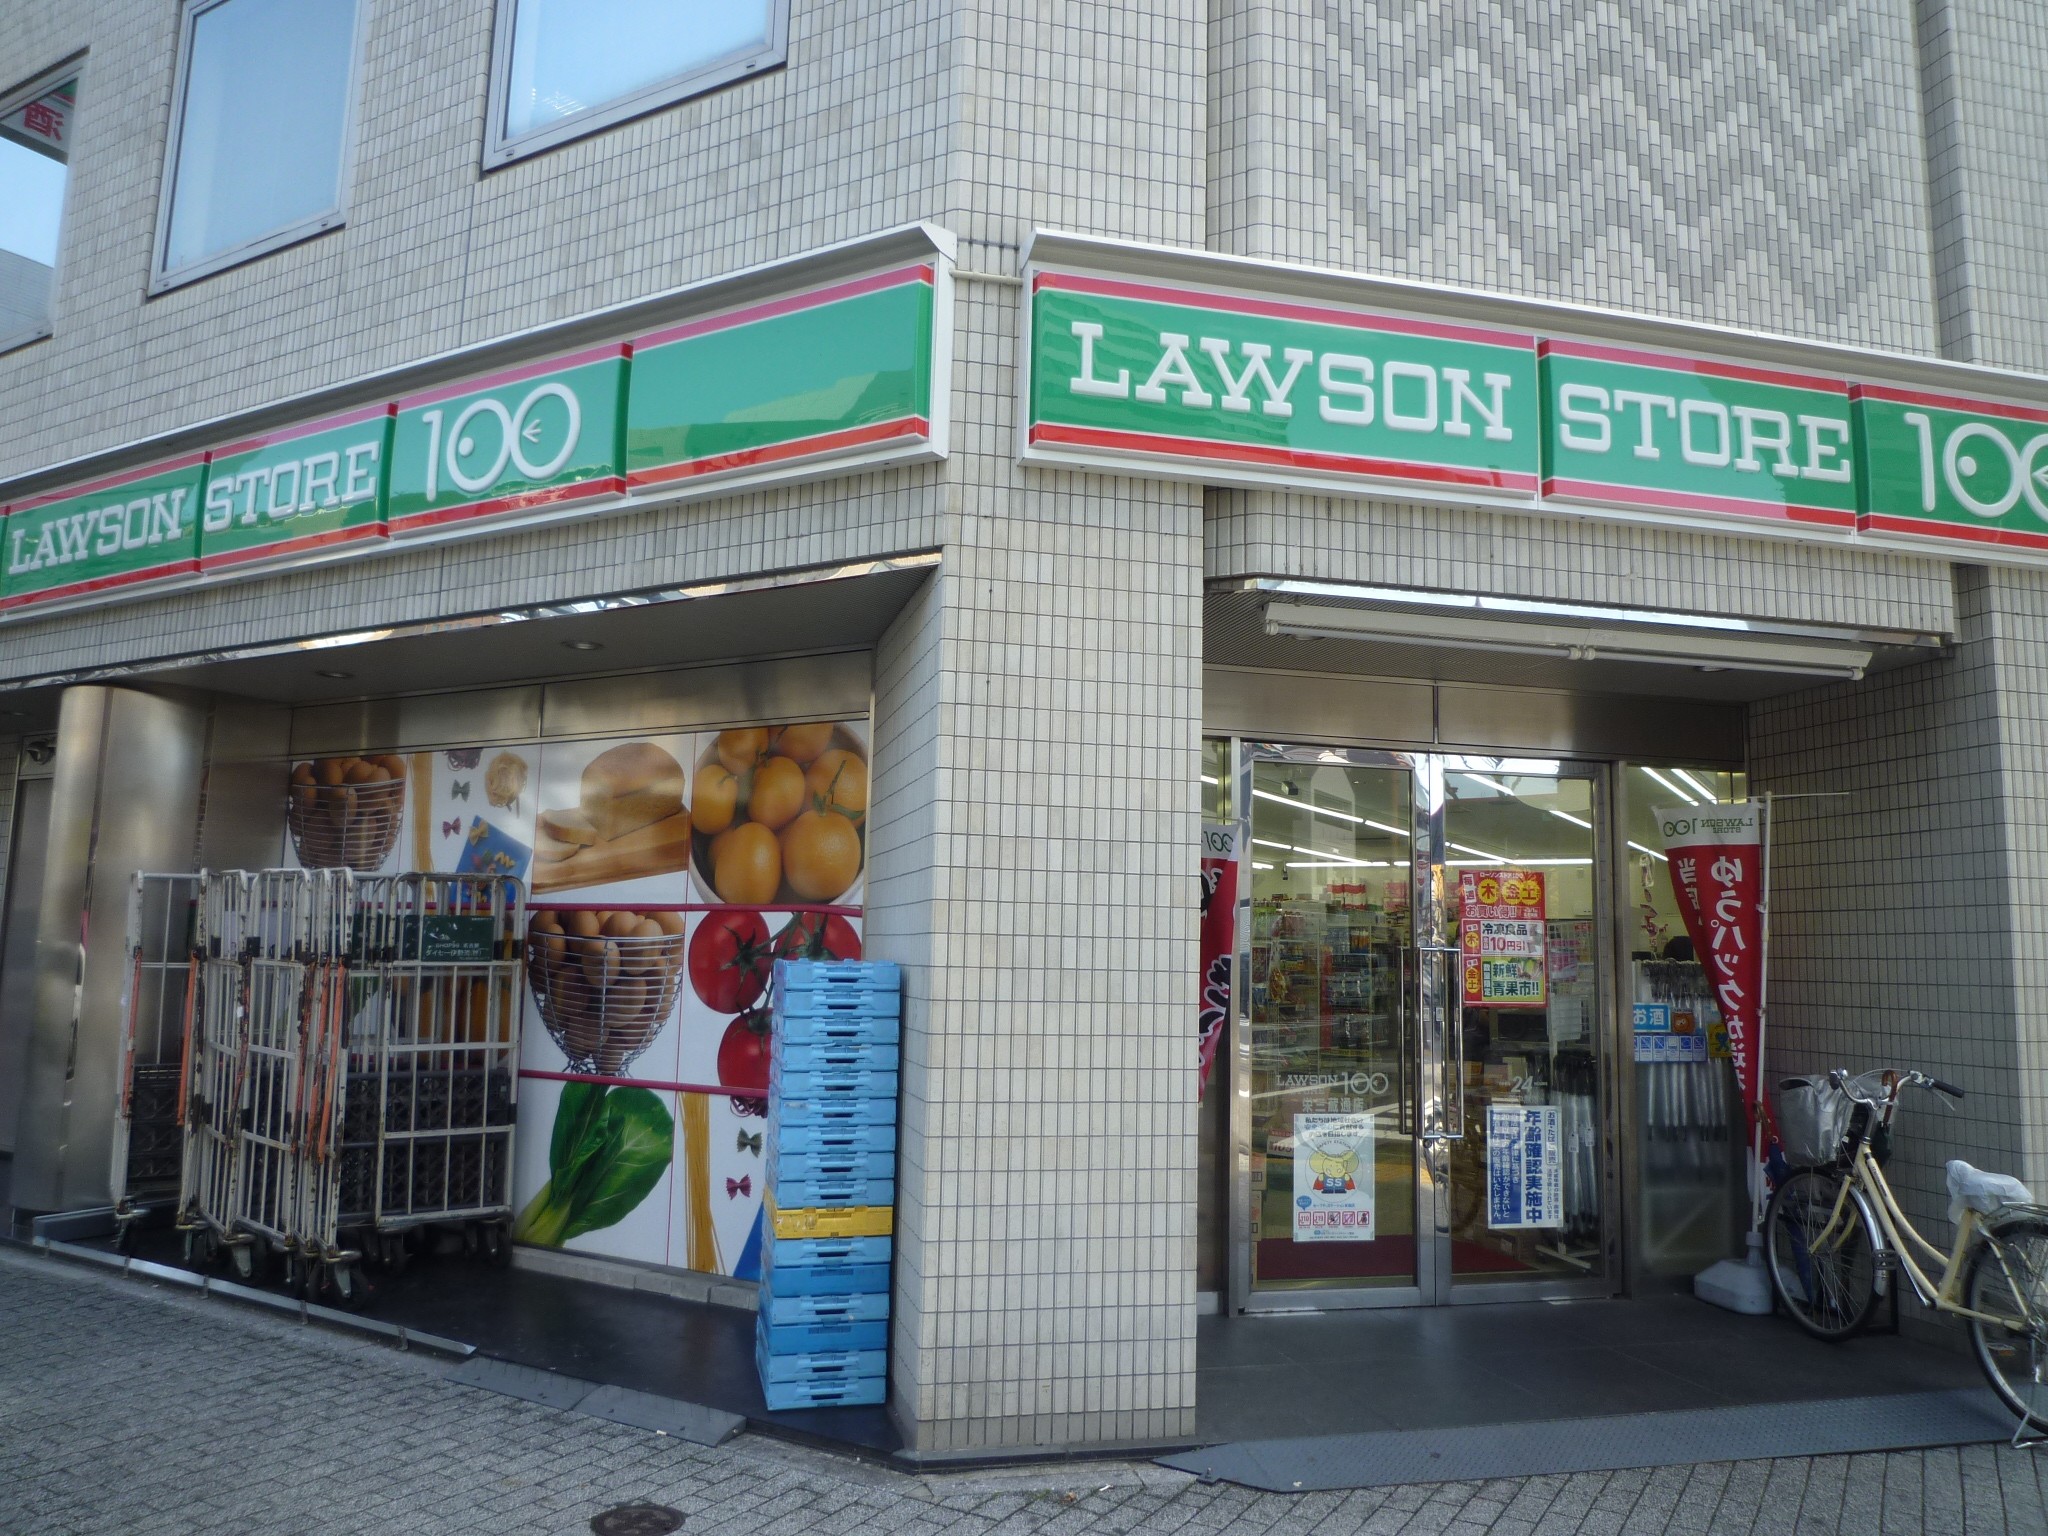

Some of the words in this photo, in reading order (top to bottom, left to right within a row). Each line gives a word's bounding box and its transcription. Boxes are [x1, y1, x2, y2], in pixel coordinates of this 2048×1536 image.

[1070, 321, 1513, 441] LAWSON
[1559, 383, 1850, 483] STORE
[8, 488, 186, 575] LAWSON
[203, 441, 380, 533] STORE
[422, 383, 582, 502] 100
[1482, 923, 1528, 935] 冷凍食品
[1493, 963, 1518, 978] 新鮮
[1633, 1008, 1665, 1026] お酒
[1276, 1074, 1338, 1086] LAWSON
[1341, 1072, 1389, 1095] 100
[1511, 1076, 1533, 1092] 24
[1525, 1110, 1542, 1223] 年齢確認実施中
[1326, 1178, 1342, 1187] SS
